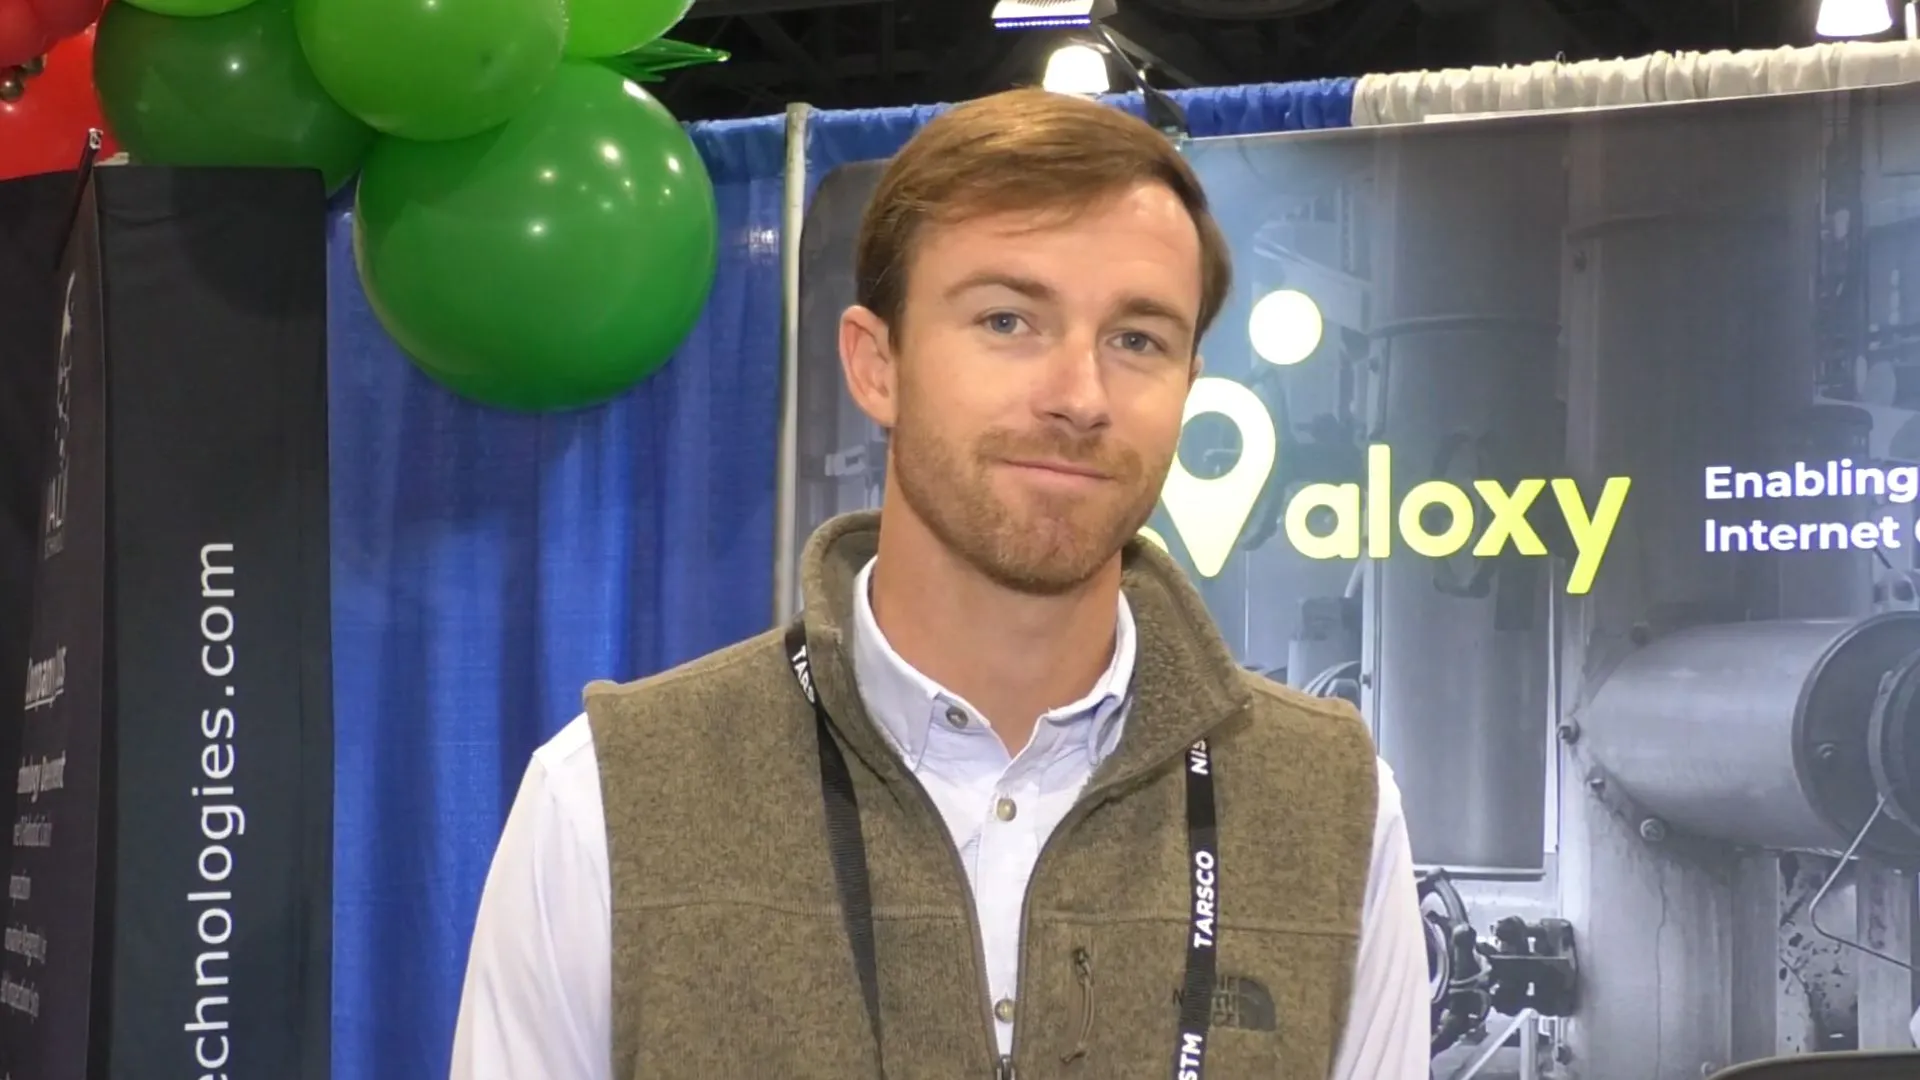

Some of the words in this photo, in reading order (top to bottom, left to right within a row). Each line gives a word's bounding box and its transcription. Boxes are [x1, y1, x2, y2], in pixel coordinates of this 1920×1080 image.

[1285, 443, 1632, 594] aloxy
[1705, 457, 1919, 503] Enabling
[1705, 516, 1901, 553] Internet
[184, 543, 246, 1080] chnologies.com
[1193, 850, 1215, 948] TARSCO
